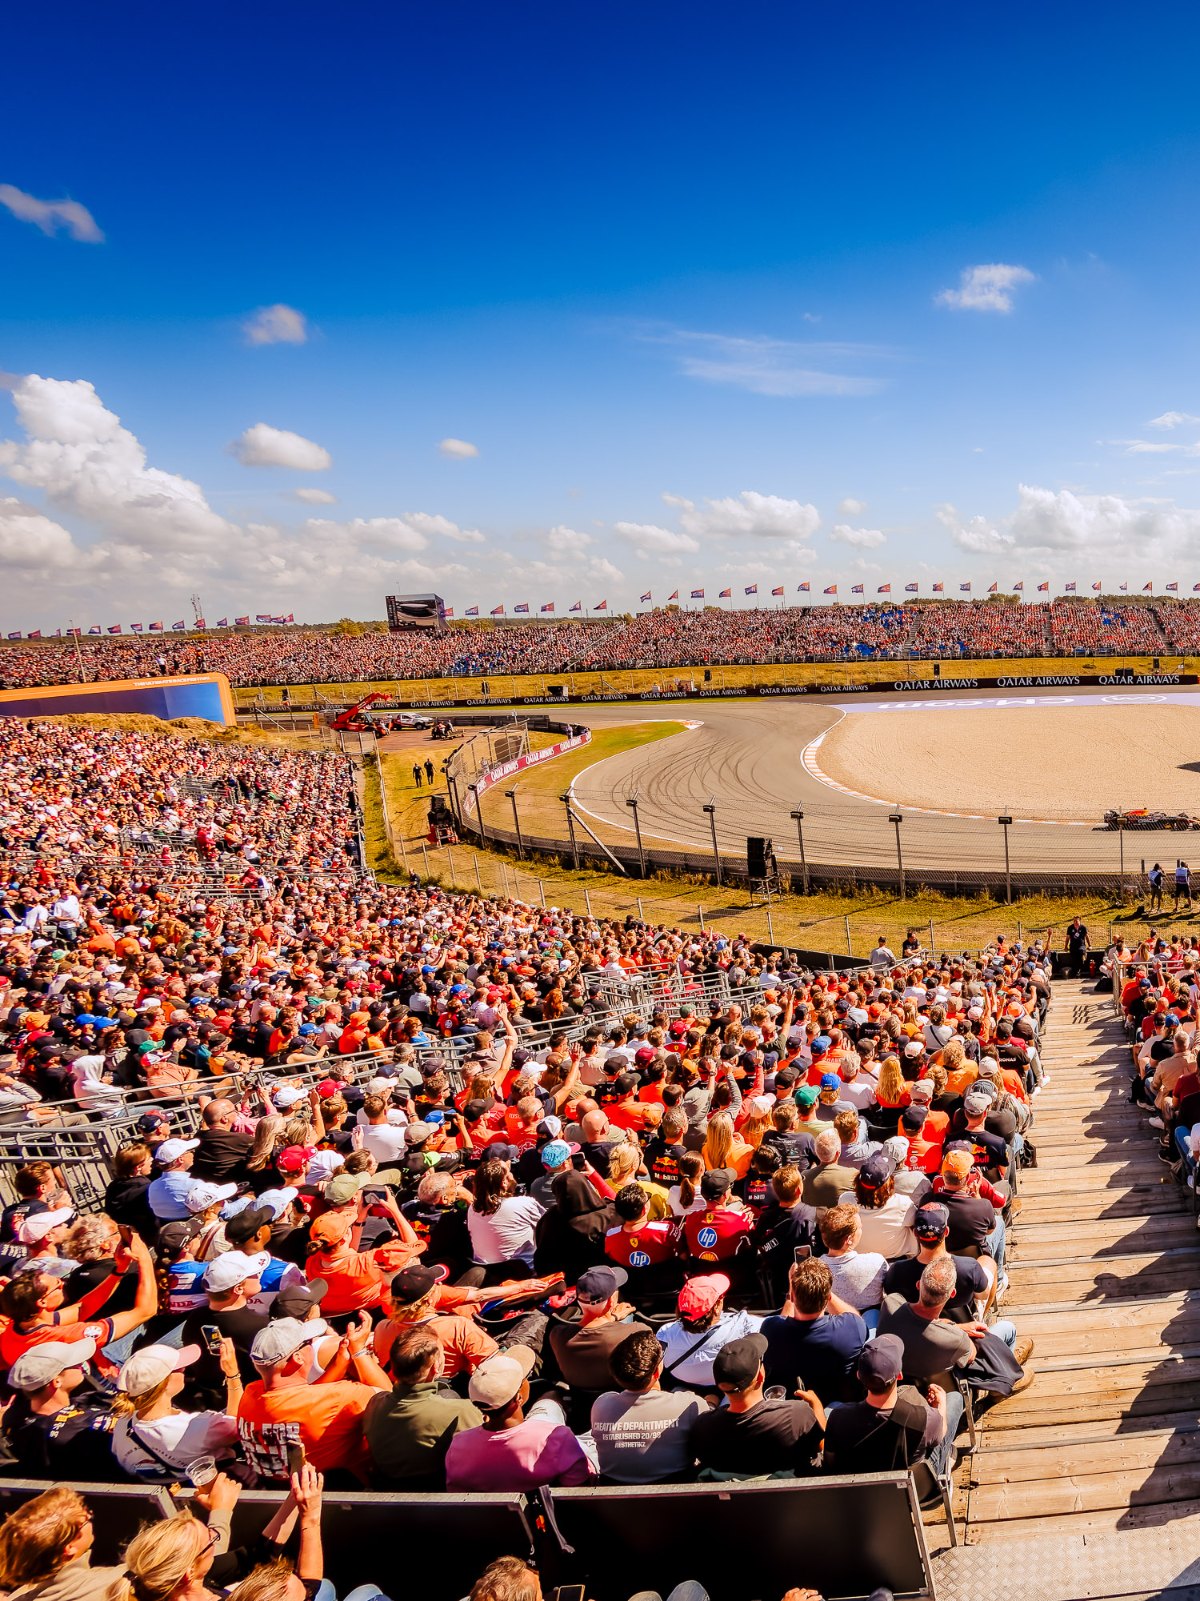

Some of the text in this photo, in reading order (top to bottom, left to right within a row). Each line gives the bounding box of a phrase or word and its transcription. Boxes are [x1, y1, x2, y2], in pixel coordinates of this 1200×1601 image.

[894, 678, 978, 691] QATAR AIRWAYS
[997, 676, 1080, 687] QATAR AIRWAYS
[1099, 675, 1180, 686] QATAR AIRWAYS
[721, 688, 747, 696] AIRWAYS
[782, 686, 808, 694] AIRWAYS
[821, 684, 869, 693] QATAR AIRWAYS
[524, 695, 569, 705] QATAR AIRWAYS
[582, 693, 628, 702] QATAR AIRWAYS
[641, 692, 660, 700] QATAR
[488, 698, 512, 706] AIRWAYS
[652, 1164, 679, 1174] Red Bull
[699, 1227, 713, 1248] hp
[633, 1252, 647, 1266] hp
[593, 1418, 680, 1432] CREATIVE DEPARTMENT
[602, 1432, 640, 1441] ESTABLISHED
